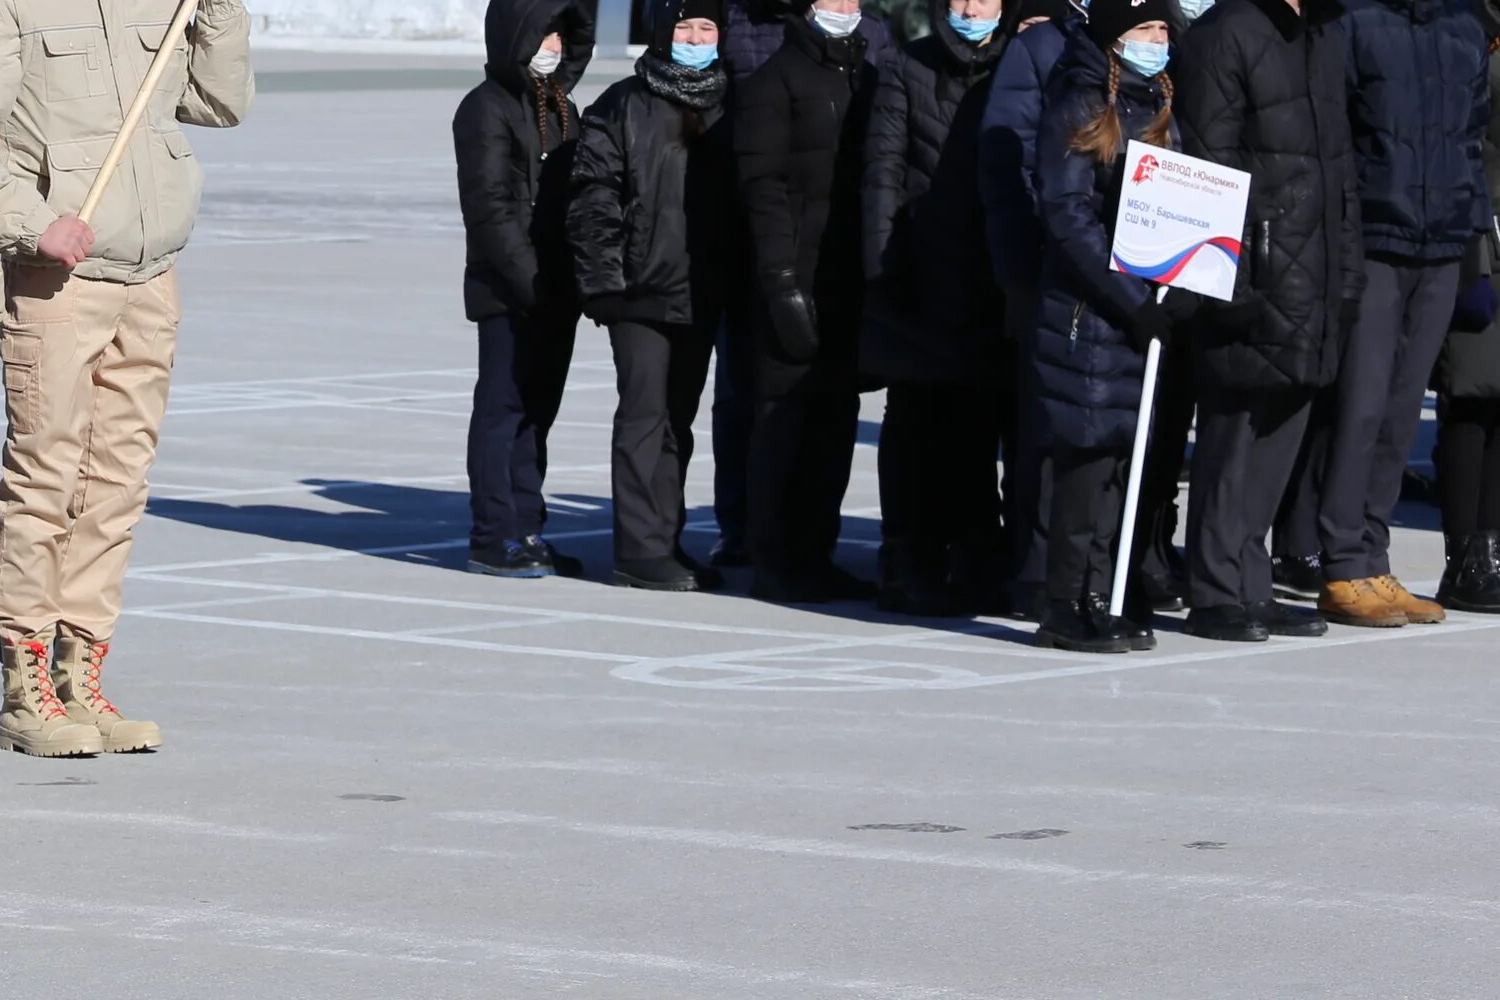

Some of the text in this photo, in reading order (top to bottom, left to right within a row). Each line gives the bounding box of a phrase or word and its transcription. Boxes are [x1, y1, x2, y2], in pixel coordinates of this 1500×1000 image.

[1161, 159, 1239, 190] ВВПОД «Юнармия»
[1124, 212, 1157, 229] СШ № 9
[1127, 197, 1150, 213] МБОУ
[1156, 206, 1210, 230] Барышевская
